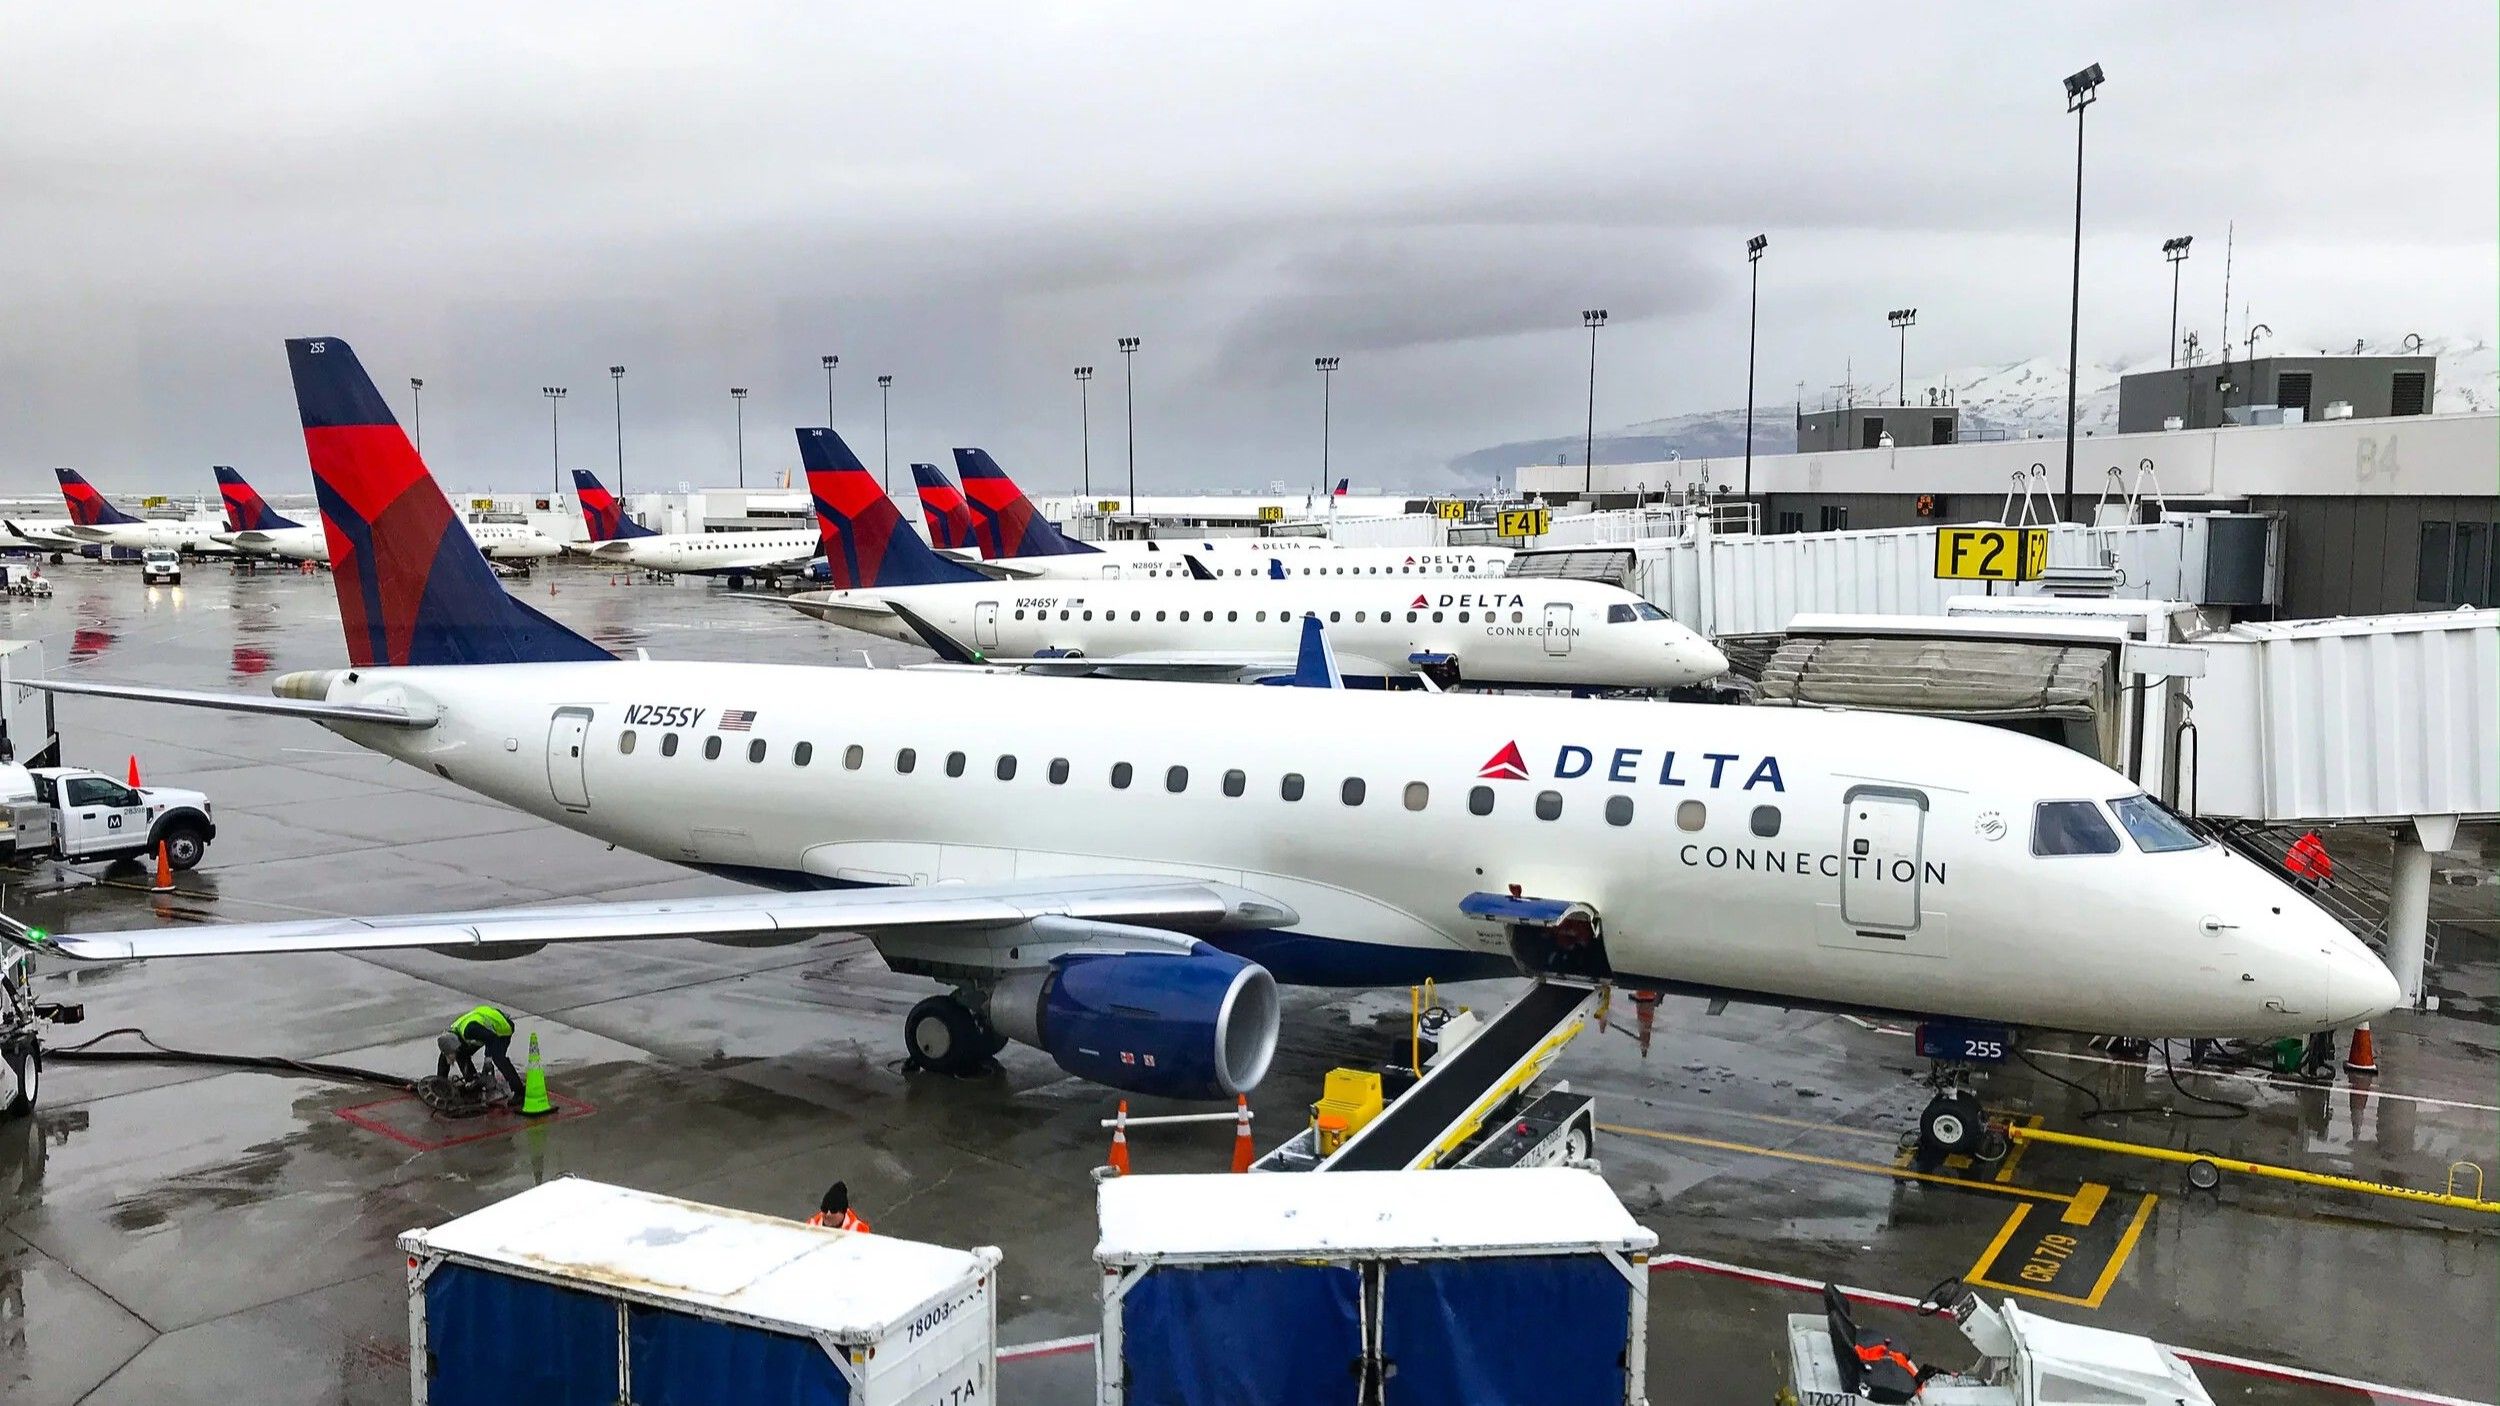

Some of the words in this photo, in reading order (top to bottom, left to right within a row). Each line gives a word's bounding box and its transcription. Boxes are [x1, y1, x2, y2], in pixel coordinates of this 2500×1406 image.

[309, 342, 325, 353] 255
[1267, 508, 1279, 519] F8
[1444, 505, 1460, 518] F6
[1503, 513, 1530, 534] F4
[1422, 555, 1475, 564] DELTA
[1951, 533, 2005, 576] F2
[2029, 533, 2045, 576] F2
[1016, 598, 1058, 608] N246SY
[1439, 594, 1524, 607] DELTA
[1486, 627, 1580, 637] CONNECTION
[624, 704, 706, 728] N255SY
[1554, 745, 1786, 793] DELTA
[1680, 844, 1946, 884] CONNECTION
[1965, 1040, 2002, 1058] 255
